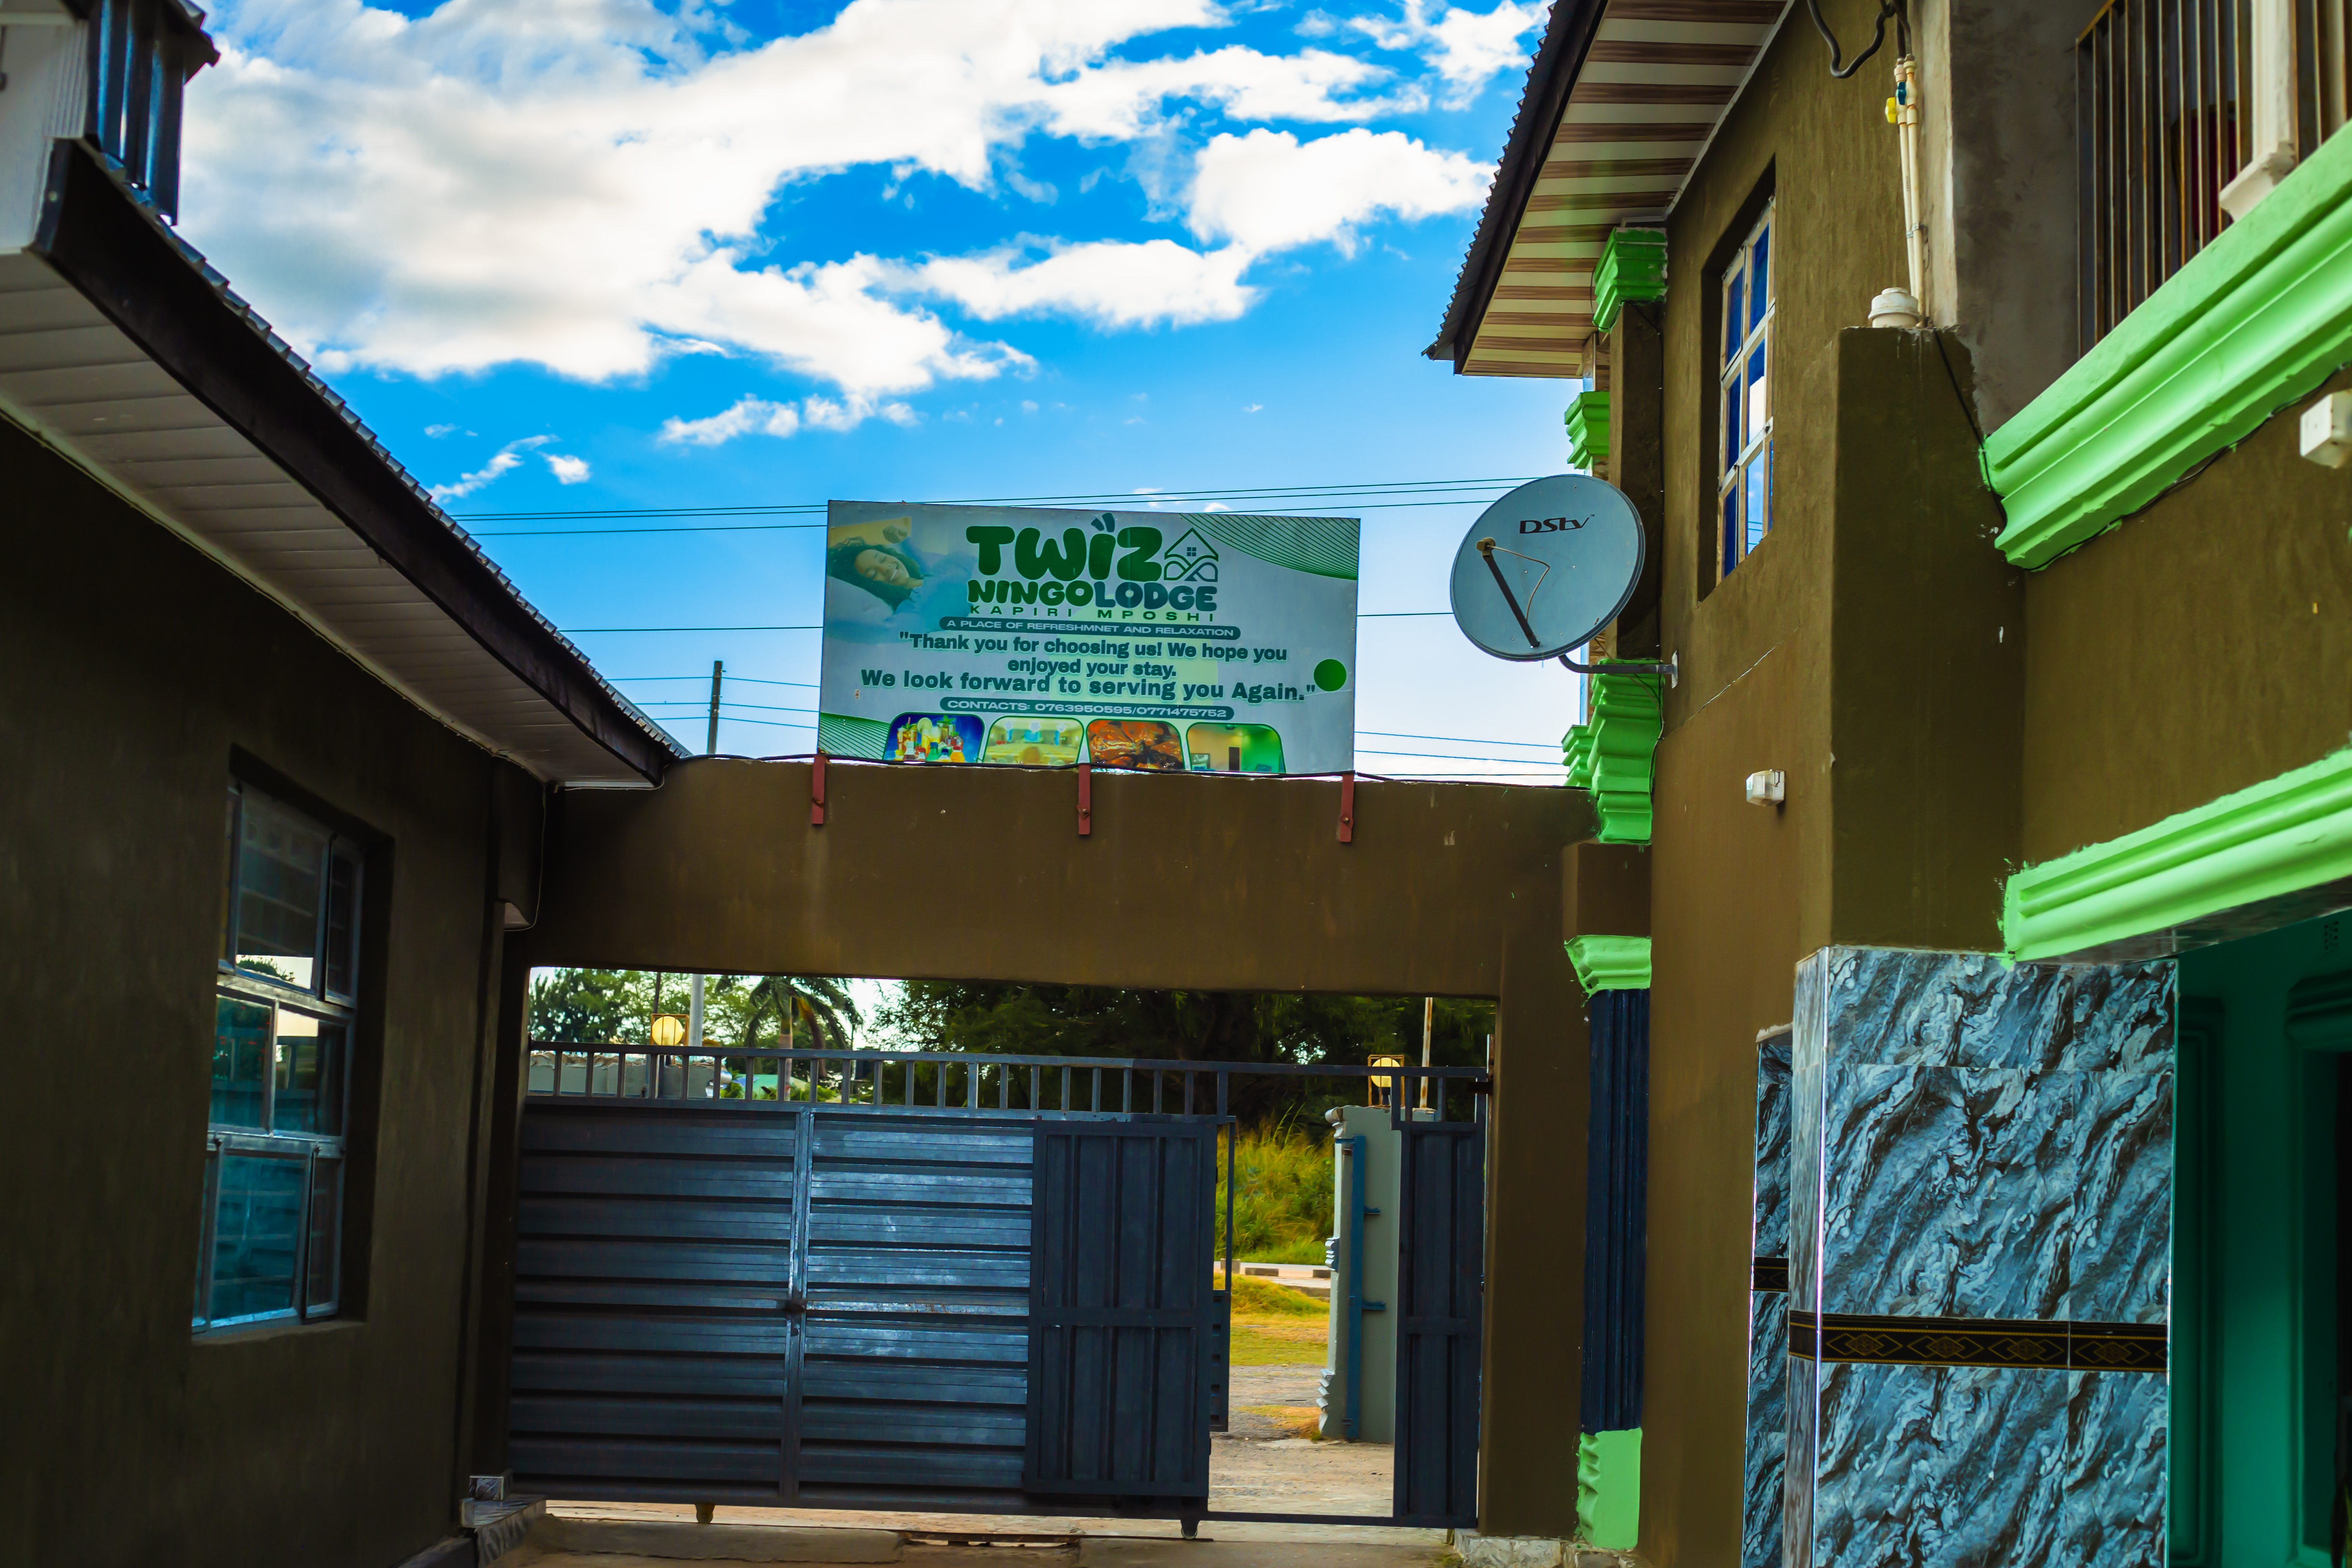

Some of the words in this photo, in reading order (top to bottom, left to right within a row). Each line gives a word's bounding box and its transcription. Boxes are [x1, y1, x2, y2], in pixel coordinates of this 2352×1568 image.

[970, 605, 1071, 617] KAPIRI
[1098, 610, 1213, 622] MPOSHI
[1027, 623, 1119, 633] REFRESHMNET
[1155, 627, 1234, 636] RELAXATION
[900, 632, 969, 650] "Thank
[974, 639, 1007, 653] you
[1013, 637, 1039, 652] for
[1044, 638, 1129, 659] choosing
[1135, 642, 1162, 656] us!
[1167, 643, 1196, 657] We
[1202, 644, 1248, 662] hope
[1253, 648, 1287, 663] you
[1008, 657, 1081, 676] enjoyed
[1086, 662, 1128, 677] your
[1133, 662, 1176, 679] stay.
[861, 670, 895, 686] We
[904, 670, 953, 689] look
[960, 673, 1049, 692] forward
[1058, 677, 1080, 693] to
[1089, 679, 1176, 701] serving
[1183, 684, 1223, 701] you
[1232, 682, 1315, 703] Again."
[947, 701, 1030, 710] CONTACTS:
